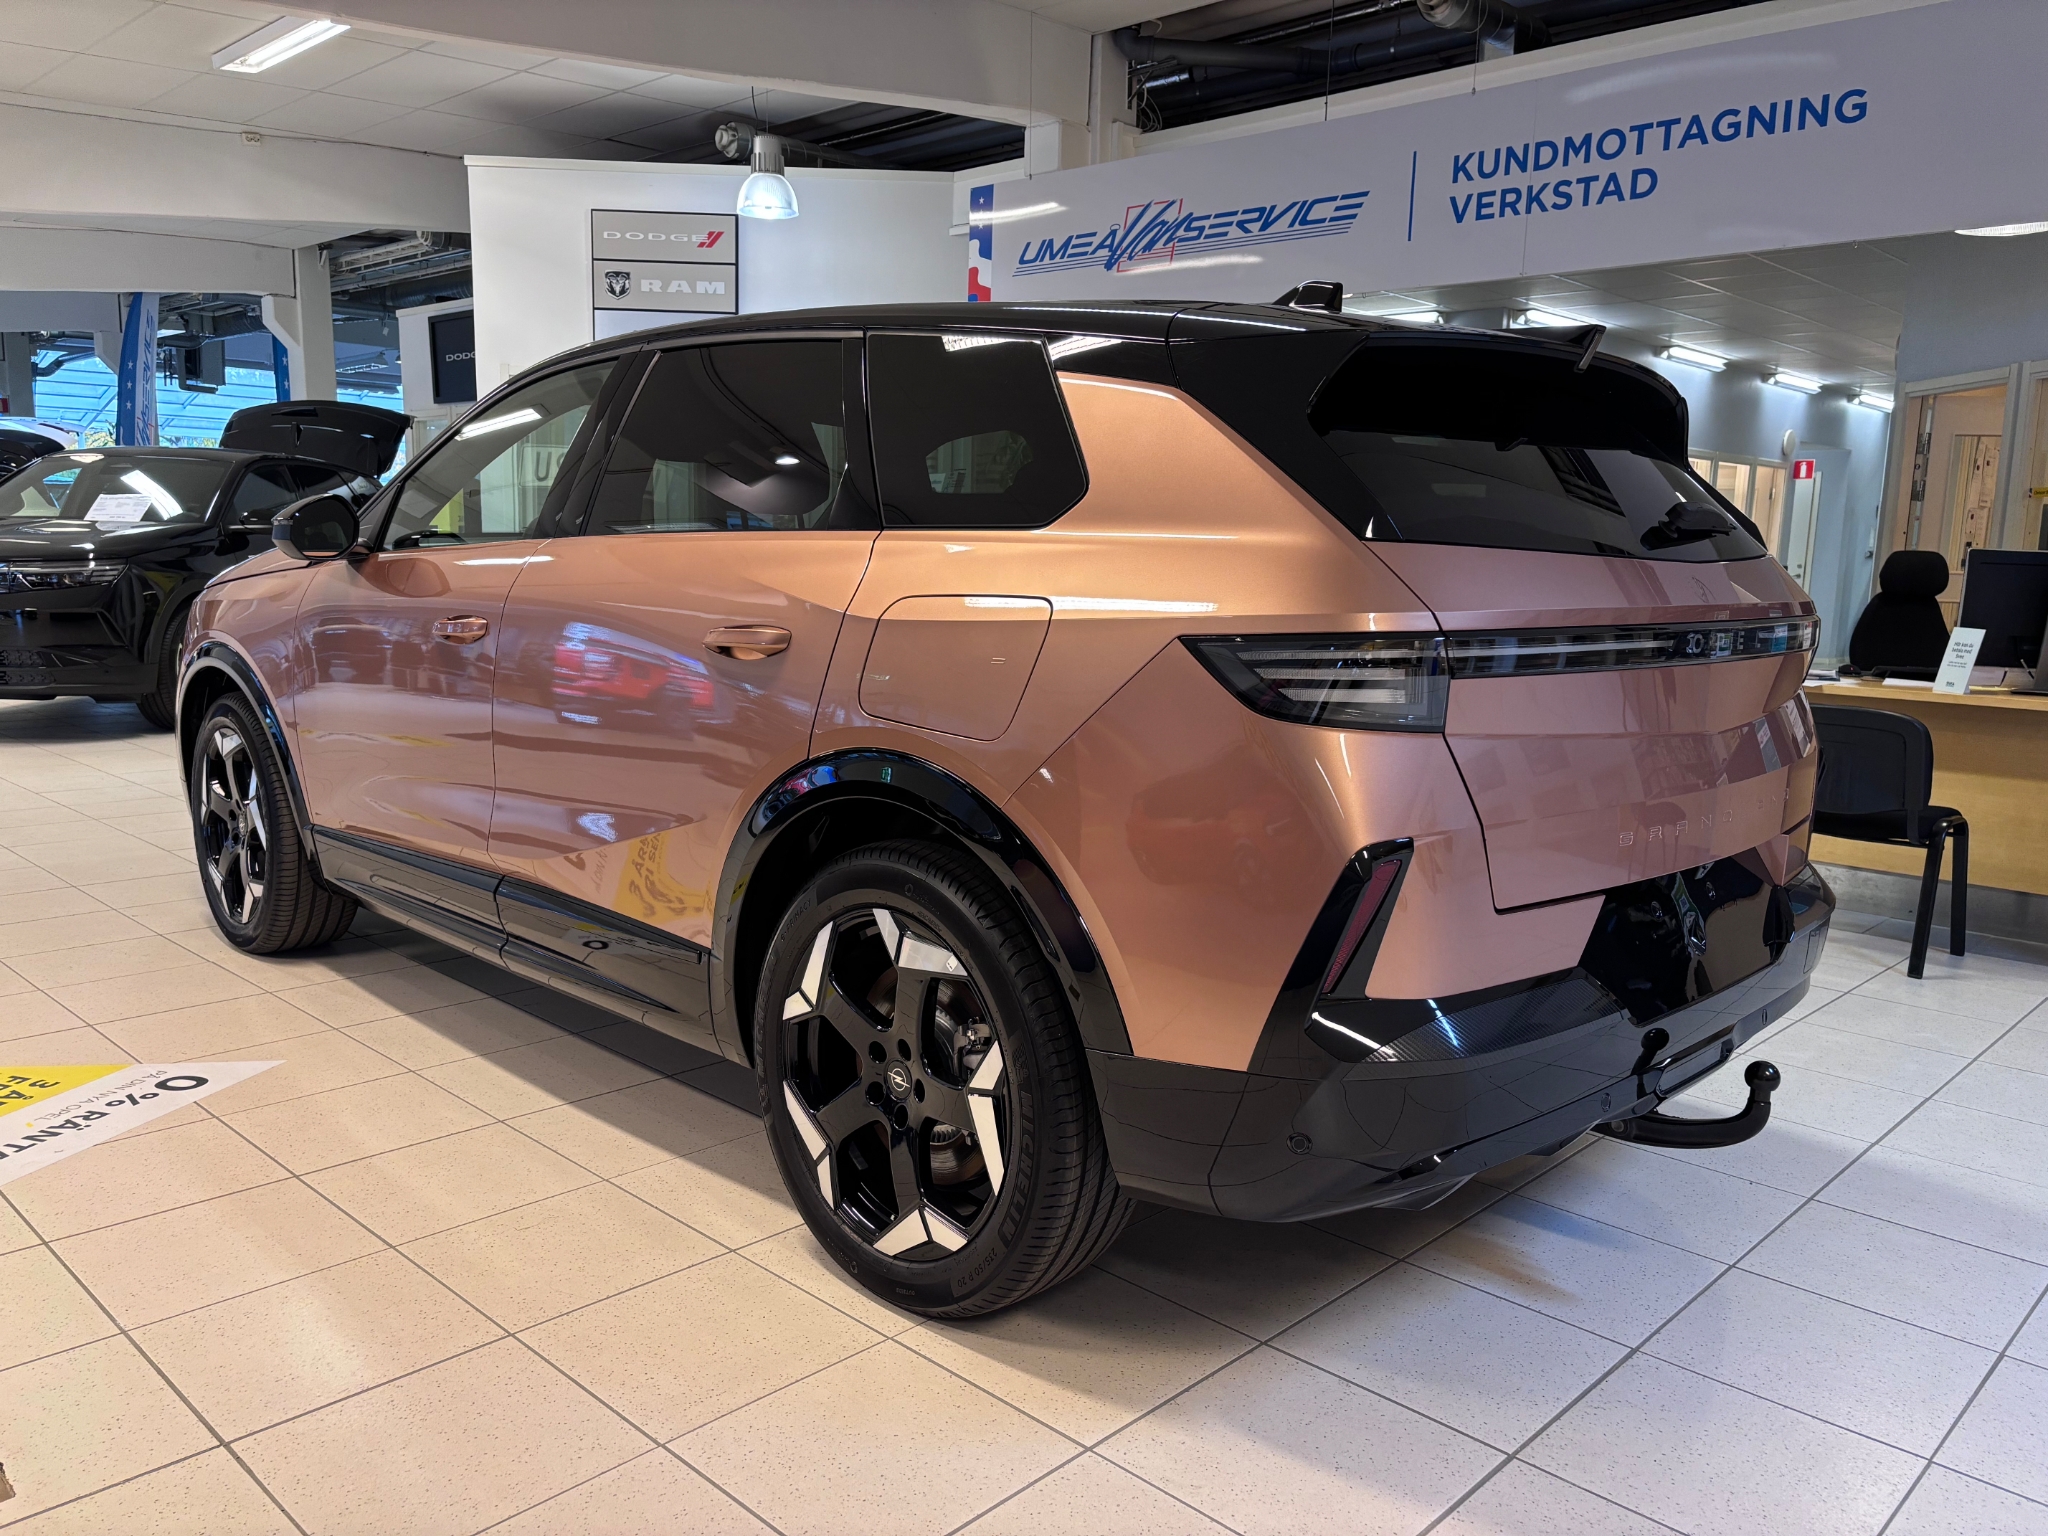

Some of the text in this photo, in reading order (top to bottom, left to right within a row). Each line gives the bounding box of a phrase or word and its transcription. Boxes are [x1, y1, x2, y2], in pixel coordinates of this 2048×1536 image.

[1451, 88, 1869, 184] KUNDMOTTAGNING
[1449, 167, 1659, 224] VERKSTAD
[603, 231, 709, 242] DODGE
[640, 279, 726, 295] RAM
[29, 1079, 62, 1089] 3
[115, 1079, 143, 1091] DIN
[79, 1090, 116, 1104] NYA
[0, 1110, 111, 1160] RÄNT
[1000, 1090, 1035, 1242] MICHELIN
